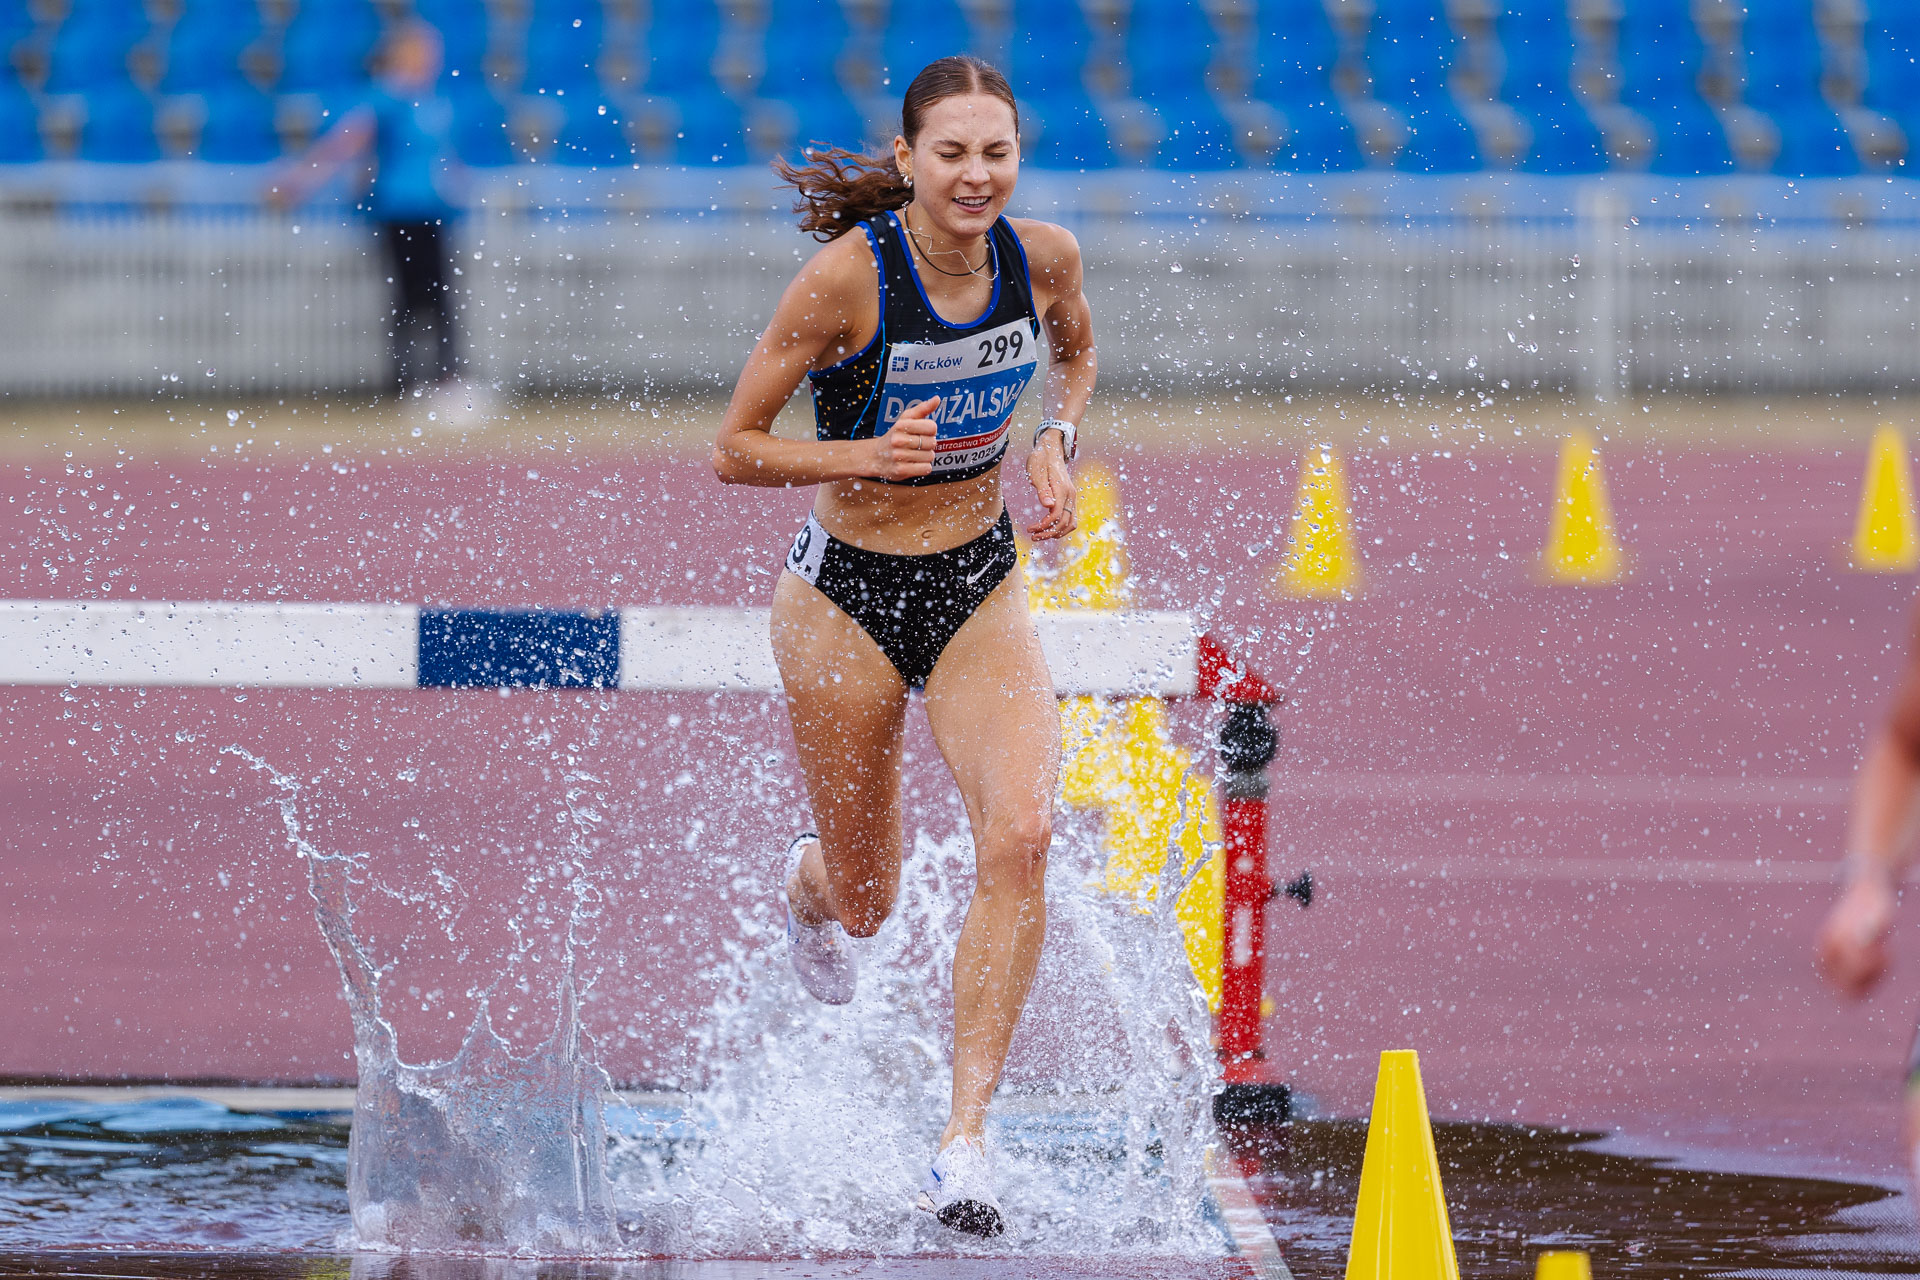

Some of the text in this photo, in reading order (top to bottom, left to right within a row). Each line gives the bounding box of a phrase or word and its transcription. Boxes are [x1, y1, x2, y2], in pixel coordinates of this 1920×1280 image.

[977, 330, 1024, 369] 299
[913, 355, 963, 370] Kraków
[934, 440, 978, 451] istrzostwa
[971, 444, 997, 462] 2025
[792, 525, 811, 563] 9
